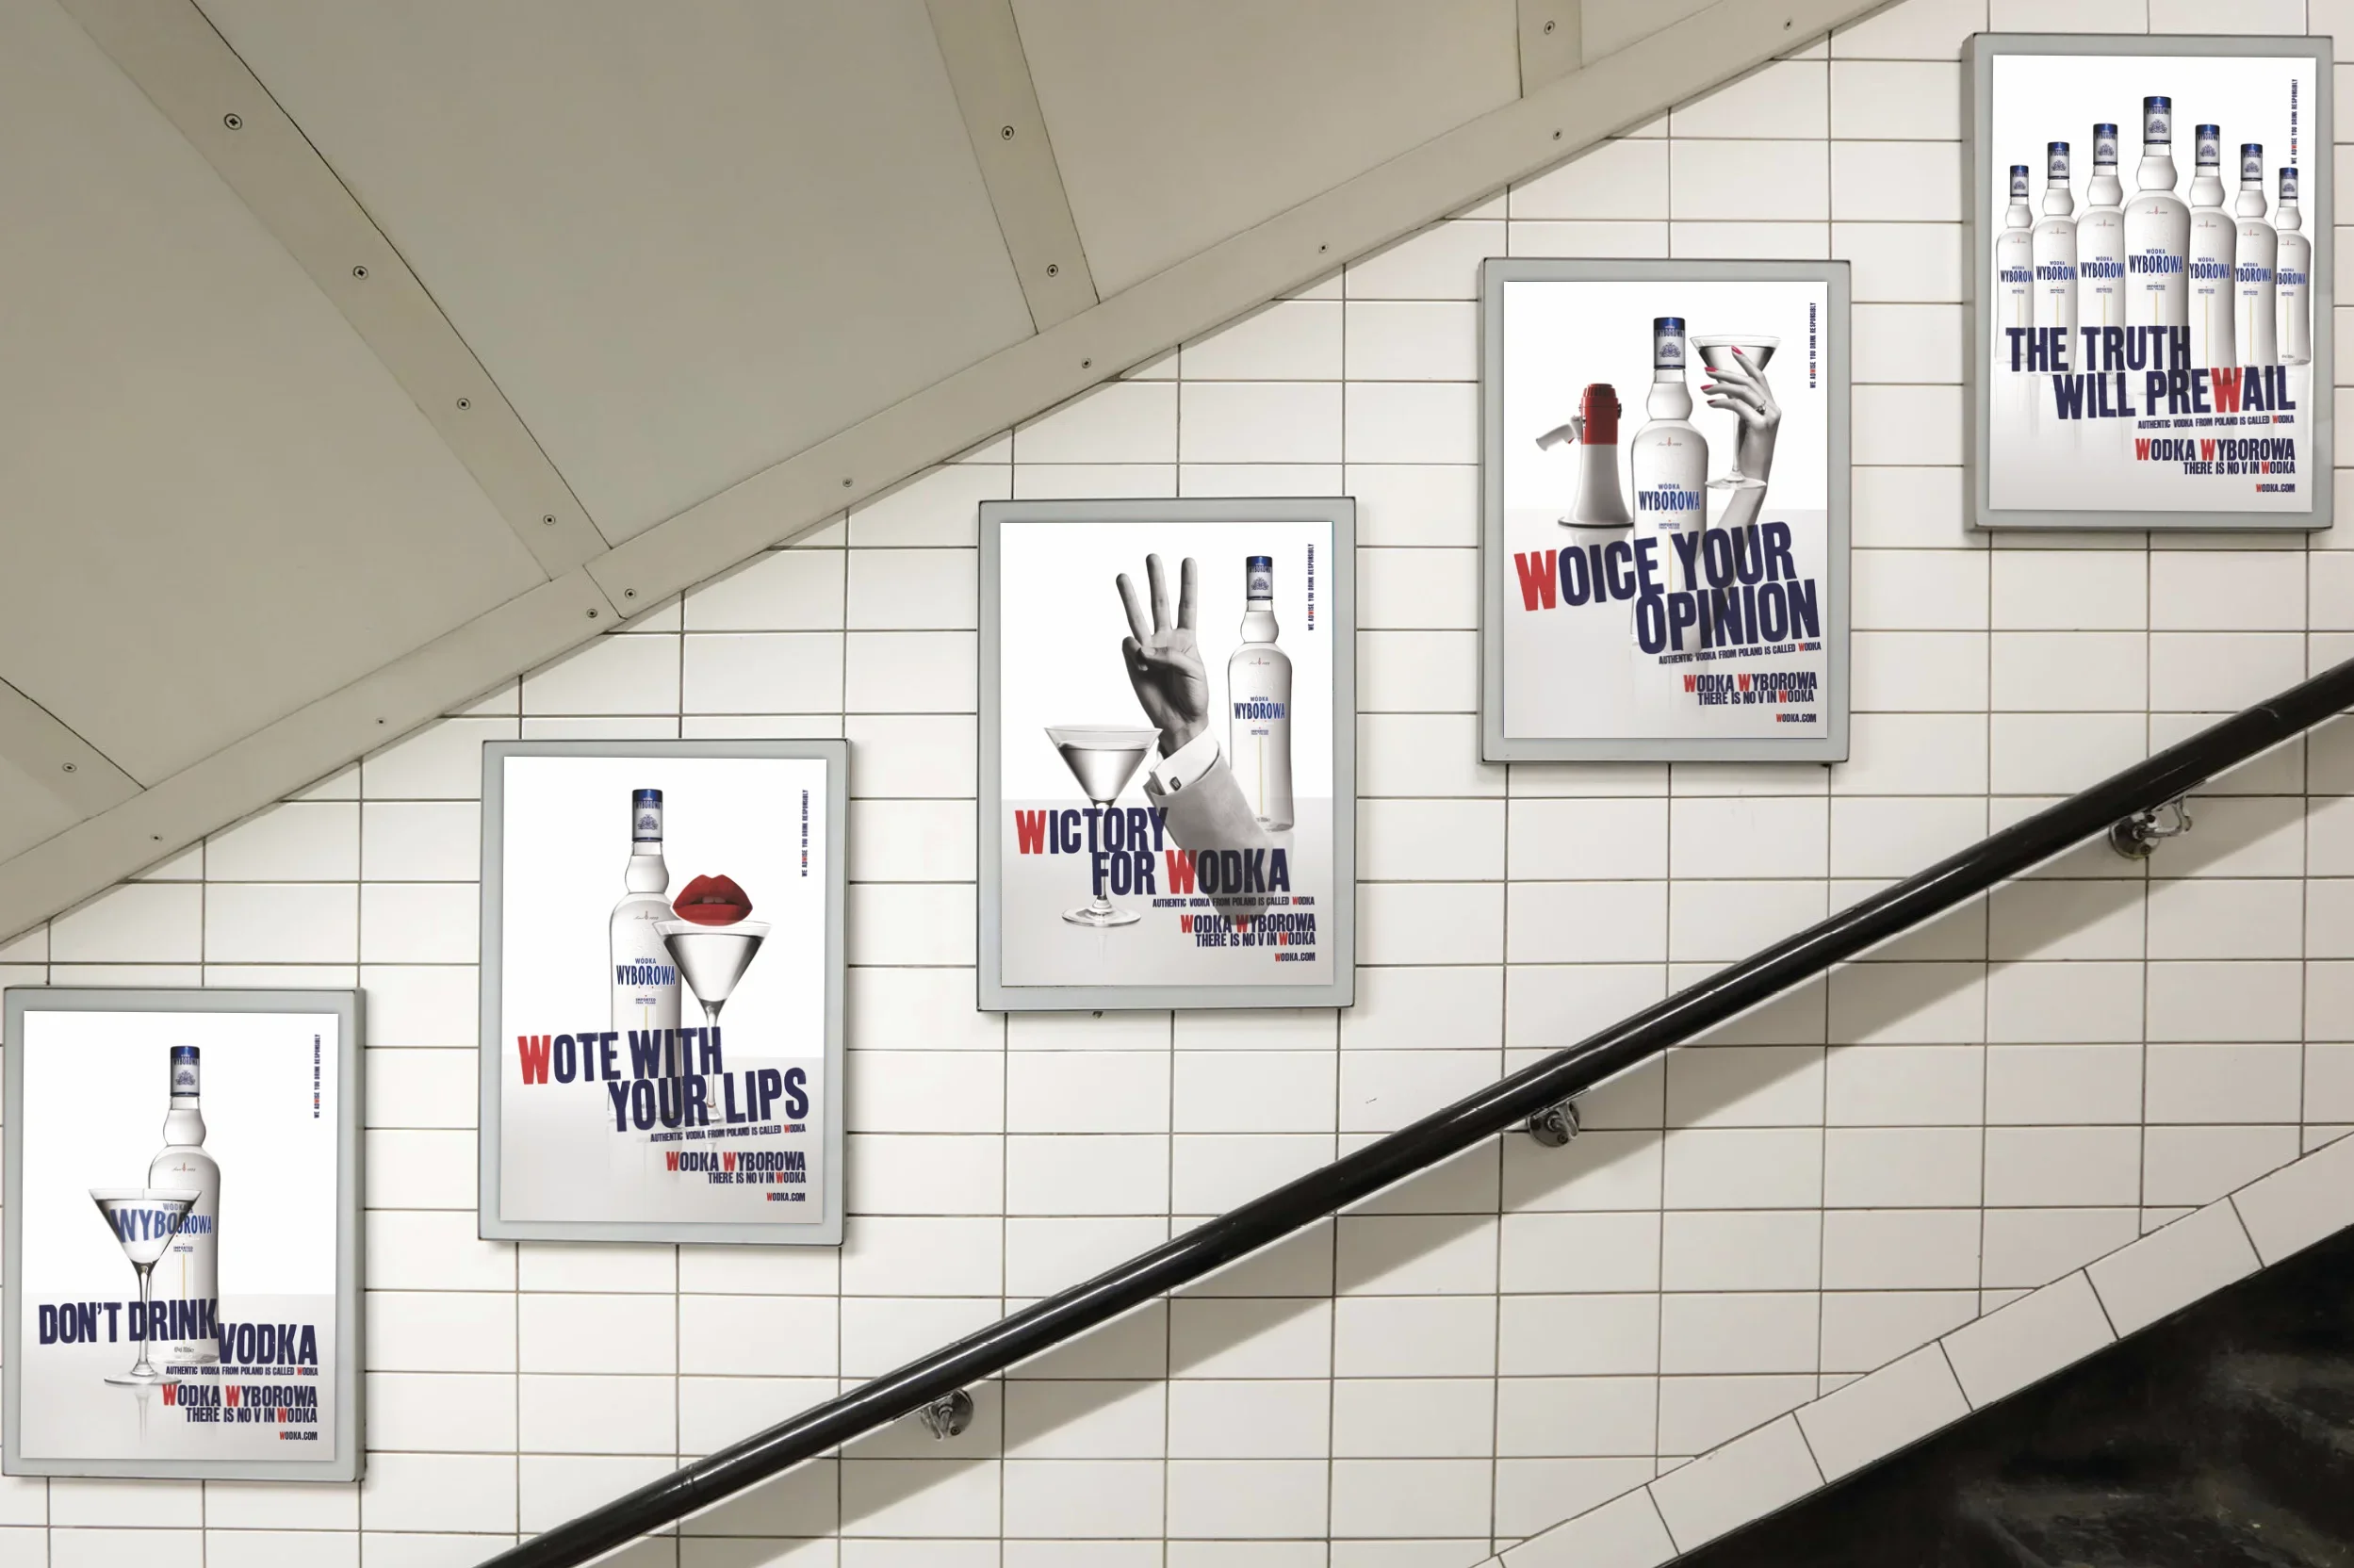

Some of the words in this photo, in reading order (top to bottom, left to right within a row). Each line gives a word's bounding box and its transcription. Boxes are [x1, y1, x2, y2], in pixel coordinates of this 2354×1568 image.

[2081, 262, 2125, 278] WYBOROW
[2129, 255, 2183, 273] WYBOROWA
[2189, 263, 2230, 279] YBOROWA
[2000, 270, 2034, 283] WYBOROW
[2235, 268, 2272, 282] YBOROWA
[2276, 272, 2306, 285] YBOROWA
[2005, 327, 2069, 372] THE
[2081, 326, 2190, 371] TRUTH
[2052, 371, 2135, 420] WILL
[2146, 366, 2296, 416] PREWAIL
[2137, 419, 2171, 429] AUTHENTIC
[2173, 418, 2194, 428] VODKA
[2196, 417, 2213, 426] FROM
[2215, 416, 2237, 426] POLAND
[2239, 416, 2247, 425] IS
[2248, 416, 2269, 424] CALLED
[2273, 415, 2295, 424] WODKA
[2135, 438, 2196, 461] WODKA
[2200, 438, 2296, 461] WYBOROWA
[2183, 462, 2213, 475] THERE
[2216, 462, 2224, 475] IS
[2228, 462, 2239, 475] NO
[2241, 462, 2248, 475] V
[2250, 462, 2260, 474] IN
[2262, 462, 2296, 474] WODKA
[2256, 483, 2296, 492] WODKA.COM
[1638, 491, 1700, 510] WYBOROWA
[1513, 537, 1664, 612] WOICE
[1670, 521, 1797, 591] YOUR
[1636, 579, 1821, 654] OPINION
[1659, 654, 1692, 664] AUTHENTIC
[1696, 651, 1717, 662] VODKA
[1719, 650, 1737, 659] FROM
[1739, 646, 1762, 658] POLAND
[1764, 645, 1771, 655] IS
[1773, 644, 1796, 654] CALLED
[1798, 642, 1821, 651] WODKA
[1683, 674, 1734, 692] WODKA
[1738, 672, 1817, 692] WYBOROWA
[1697, 692, 1727, 705] THERE
[1731, 692, 1741, 704] IS
[1743, 691, 1756, 704] NO
[1758, 691, 1765, 704] V
[1767, 690, 1776, 703] IN
[1778, 690, 1814, 703] WODKA
[1234, 703, 1285, 719] WYBOROWA
[1776, 714, 1816, 723] WODKA.COM
[1015, 807, 1169, 854] WICTORY
[1092, 851, 1156, 895] FOR
[1165, 848, 1291, 894] WODKA
[1152, 898, 1186, 907] AUTHENTIC
[1189, 898, 1210, 906] VODKA
[1213, 897, 1230, 906] FROM
[1233, 897, 1256, 906] POLAND
[1259, 897, 1265, 906] IS
[1267, 897, 1289, 906] CALLED
[1292, 897, 1315, 906] WODKA
[1181, 914, 1232, 933] WODKA
[1236, 913, 1316, 933] WYBOROWA
[1196, 933, 1226, 947] THERE
[1230, 933, 1239, 946] IS
[1242, 933, 1255, 946] NO
[1258, 933, 1265, 946] V
[1267, 933, 1277, 945] IN
[1279, 932, 1316, 945] WODKA
[1275, 953, 1316, 962] WODKA.COM
[616, 965, 675, 986] WYBOROWA
[517, 1032, 621, 1085] WOTE
[628, 1026, 723, 1079] WITH
[607, 1074, 711, 1132] YOUR
[723, 1068, 809, 1123] LIPS
[650, 1133, 683, 1142] AUTHENTIC
[686, 1132, 706, 1140] VODKA
[708, 1130, 725, 1138] FROM
[727, 1128, 749, 1137] POLAND
[752, 1127, 758, 1135] IS
[760, 1125, 781, 1135] CALLED
[784, 1124, 806, 1133] WODKA
[666, 1152, 719, 1171] WODKA
[723, 1152, 806, 1171] WYBOROWA
[708, 1172, 733, 1184] THERE
[736, 1172, 744, 1184] IS
[746, 1172, 757, 1184] NO
[759, 1172, 764, 1184] V
[766, 1172, 775, 1184] IN
[776, 1172, 806, 1184] WODKA
[767, 1193, 805, 1201] WODKA.COM
[39, 1302, 123, 1345] DON'T
[128, 1298, 219, 1341] DRINK
[218, 1323, 318, 1364] VODKA
[166, 1366, 198, 1375] AUTHENTIC
[201, 1366, 220, 1375] VODKA
[222, 1366, 238, 1375] FROM
[240, 1366, 263, 1375] POLAND
[266, 1366, 270, 1375] IS
[273, 1366, 294, 1375] CALLED
[297, 1367, 319, 1376] WODKA
[162, 1384, 221, 1406] WODKA
[226, 1385, 318, 1407] WYBOROWA
[186, 1408, 220, 1422] THERE
[224, 1408, 234, 1422] IS
[237, 1408, 251, 1422] NO
[254, 1408, 261, 1422] V
[264, 1408, 275, 1422] IN
[277, 1408, 318, 1422] WODKA
[280, 1431, 318, 1440] WODKA.COM
